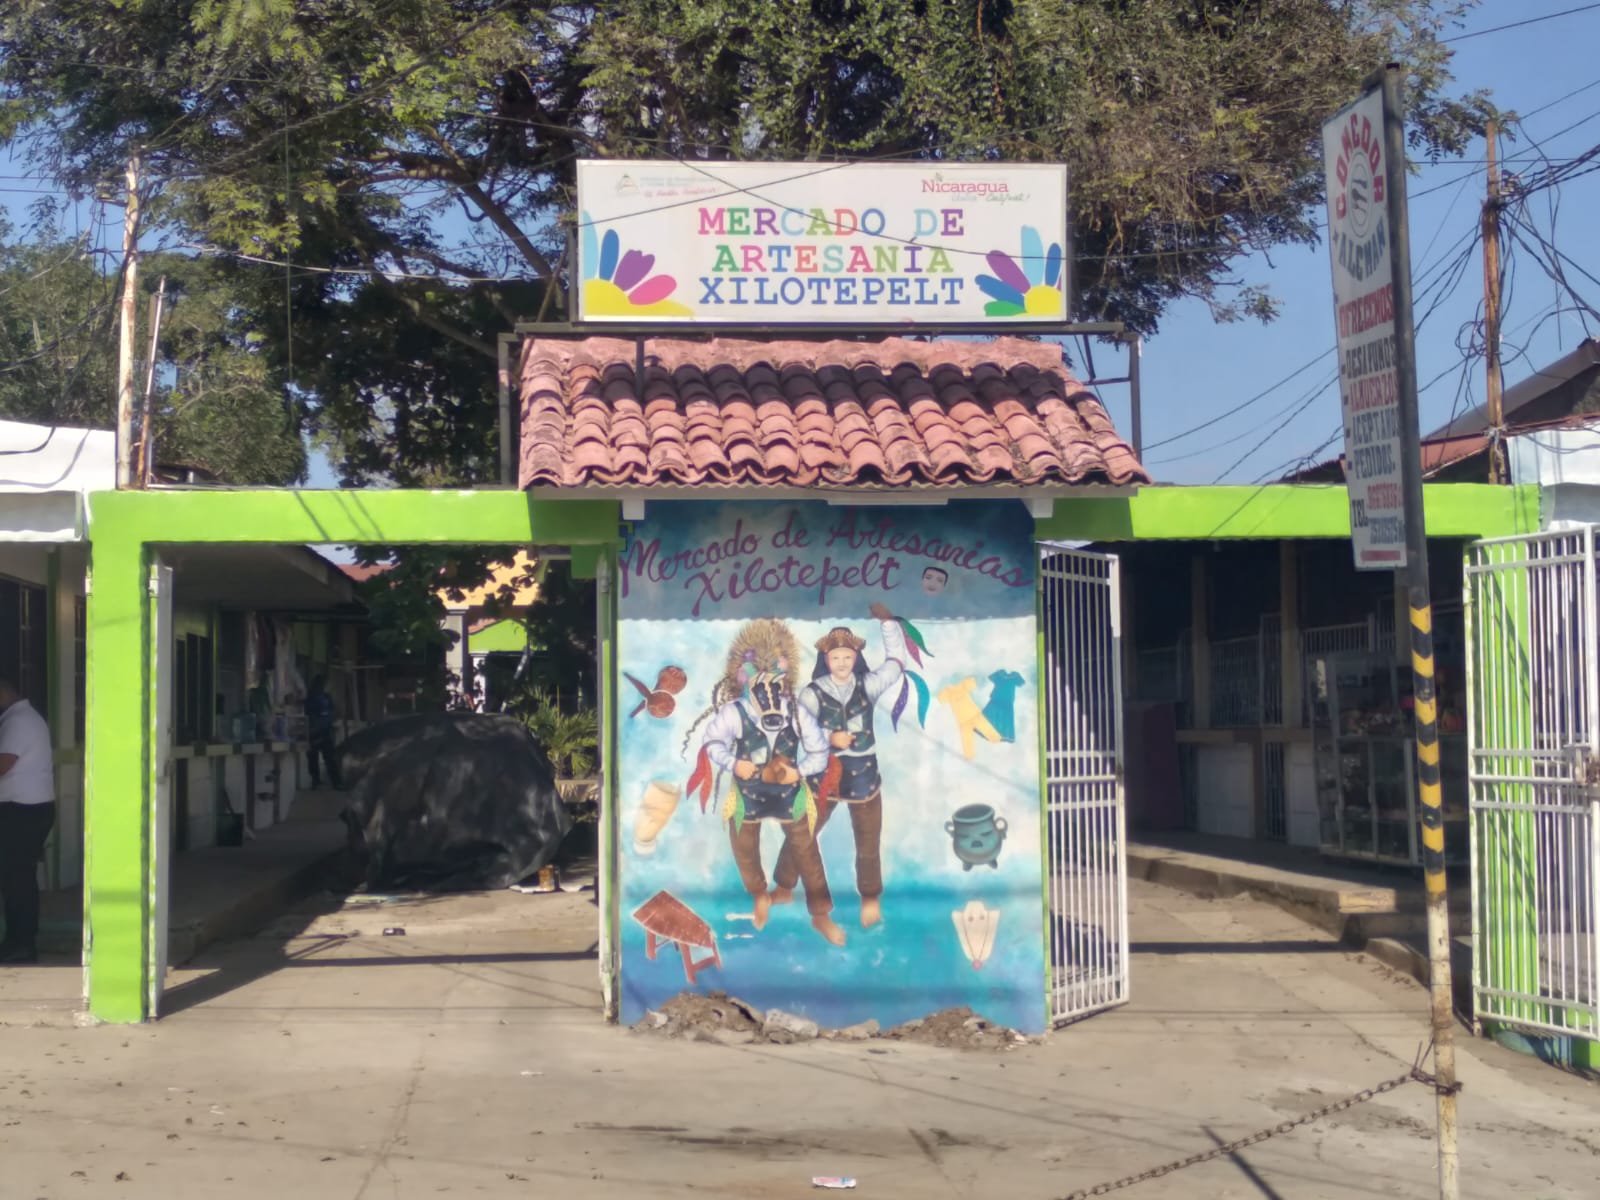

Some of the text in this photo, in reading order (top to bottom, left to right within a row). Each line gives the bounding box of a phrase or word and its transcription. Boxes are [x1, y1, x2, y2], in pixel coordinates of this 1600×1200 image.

[921, 178, 1009, 196] Nicaragua
[1335, 112, 1384, 219] COMEDOR
[698, 207, 964, 237] MERCADO DE
[712, 245, 954, 274] ARTESANIA
[699, 277, 964, 306] XILOTEPELT
[1339, 283, 1394, 339] OFRECEMOS
[618, 519, 758, 599] Mercado
[771, 510, 809, 549] de
[684, 552, 900, 616] Xilotepelt
